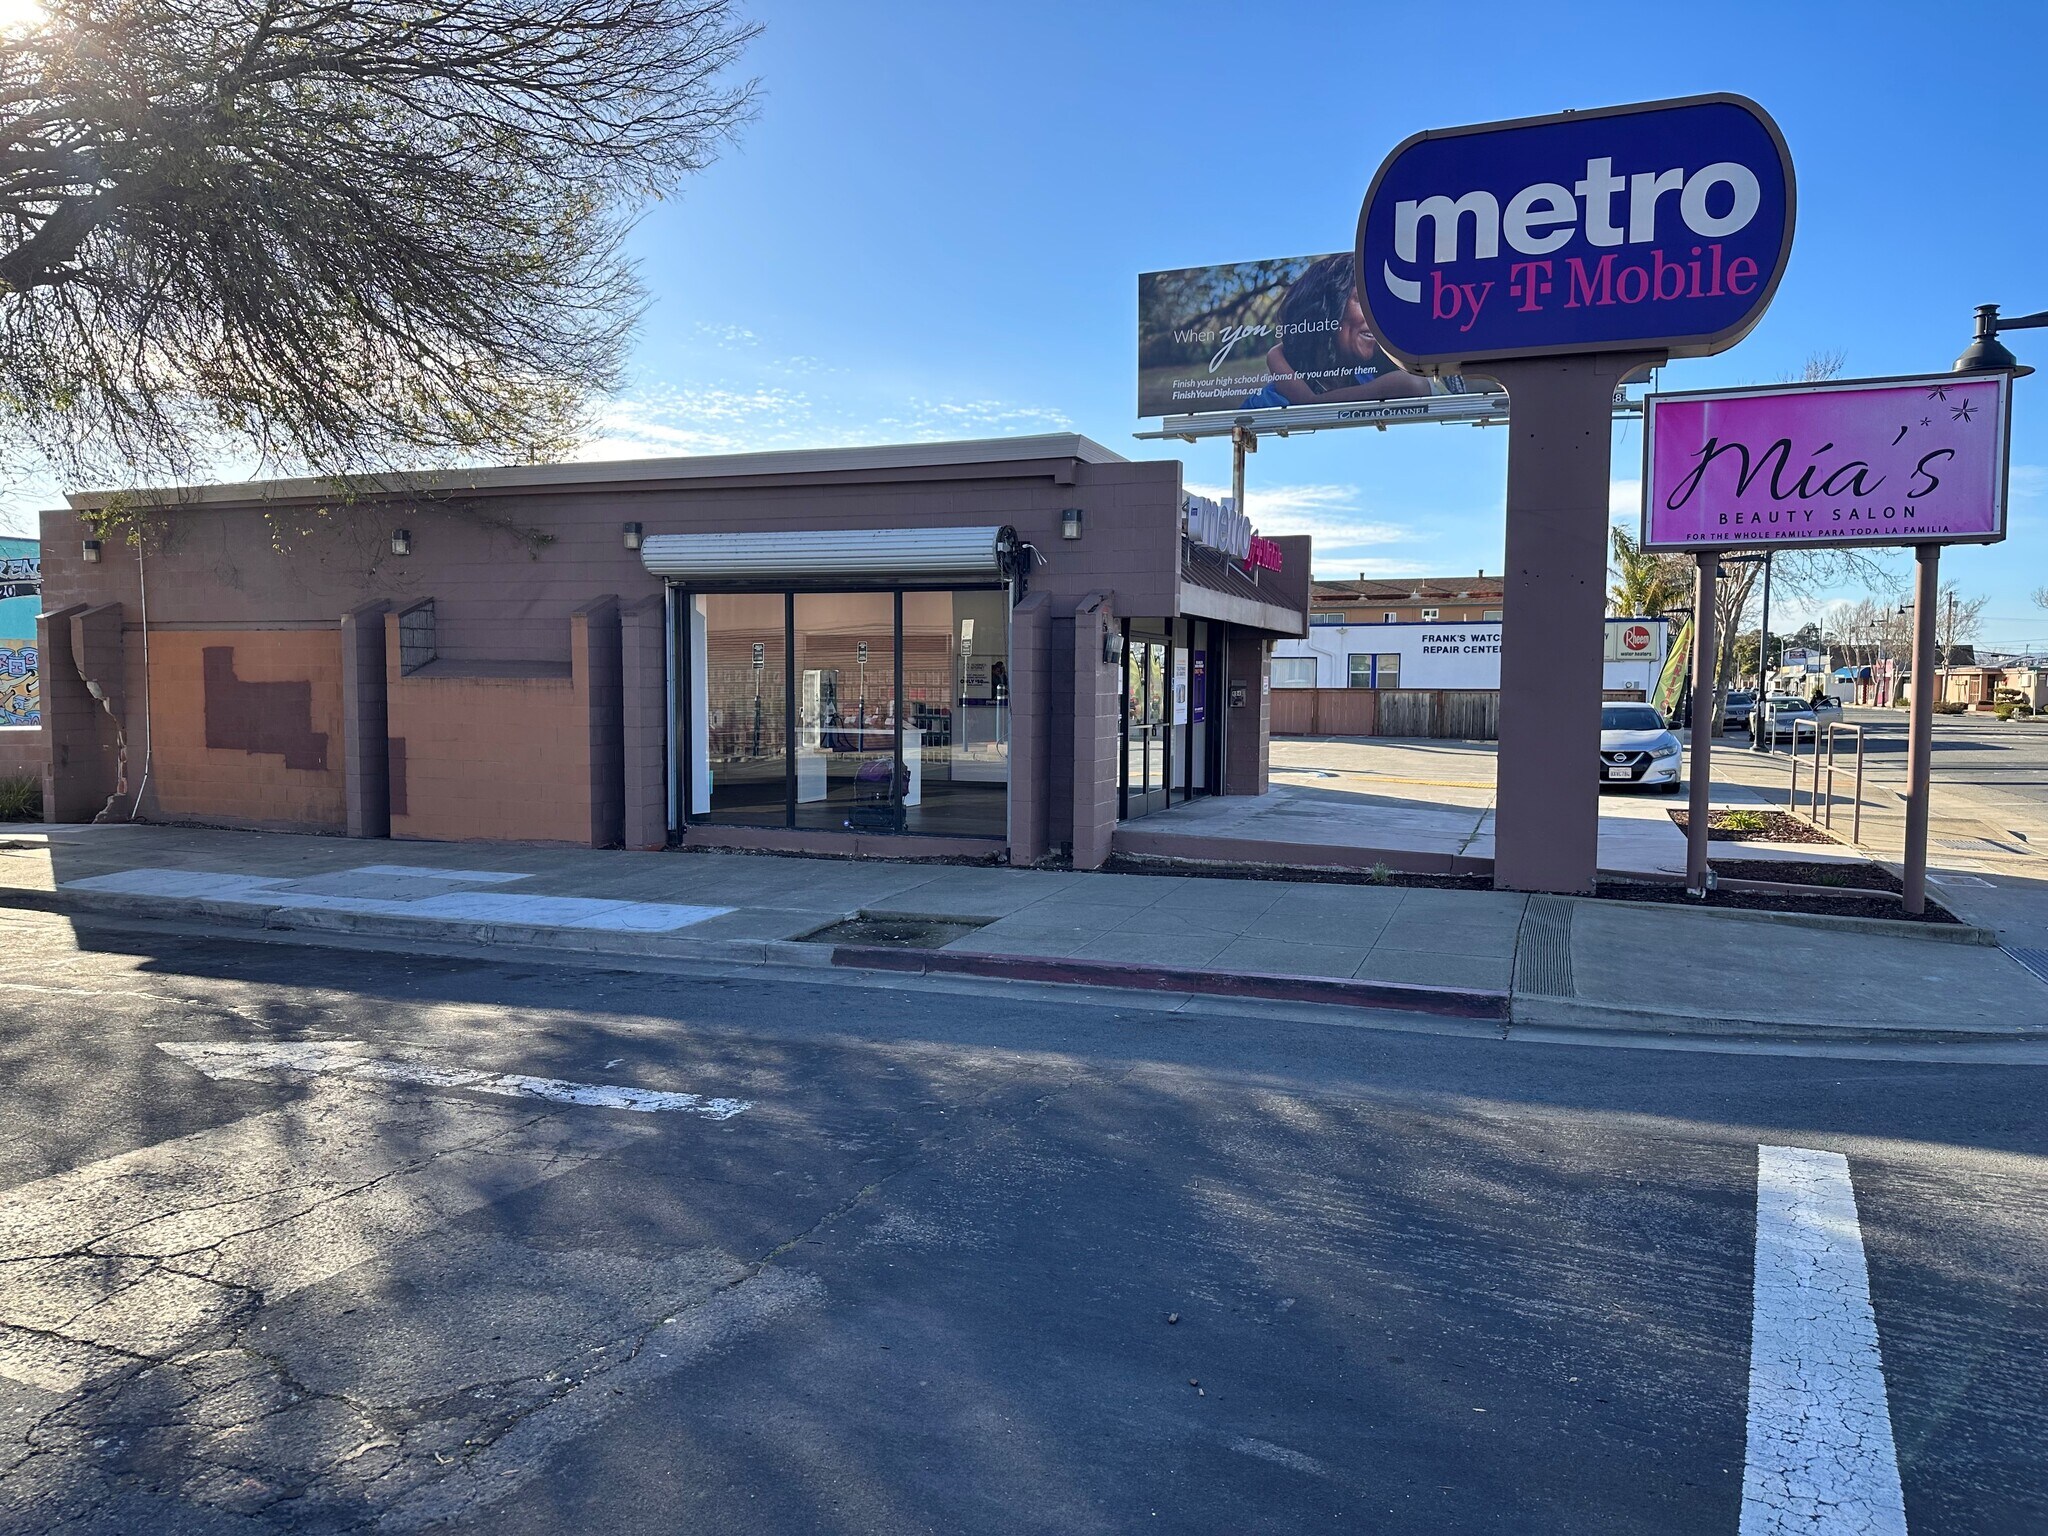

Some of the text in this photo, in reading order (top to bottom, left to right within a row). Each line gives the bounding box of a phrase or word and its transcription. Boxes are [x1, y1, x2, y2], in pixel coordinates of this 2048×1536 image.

[1394, 156, 1761, 264] metro
[1430, 271, 1495, 332] by
[1563, 245, 1759, 308] Mobile
[1173, 318, 1343, 374] When you graduate,
[1172, 364, 1378, 390] Finish your high school diploma for you and for them.
[1172, 386, 1263, 400] FinishYourDiploma.org
[1719, 505, 1917, 525] BEAUTY SALON
[1686, 525, 1950, 541] FOR THE WHOLE FAMILY PARA TODA LA FAMILIA
[1421, 633, 1502, 643] FRANK'S WATC
[1625, 626, 1649, 648] Rheem
[1422, 645, 1502, 654] REPAIR CENTE
